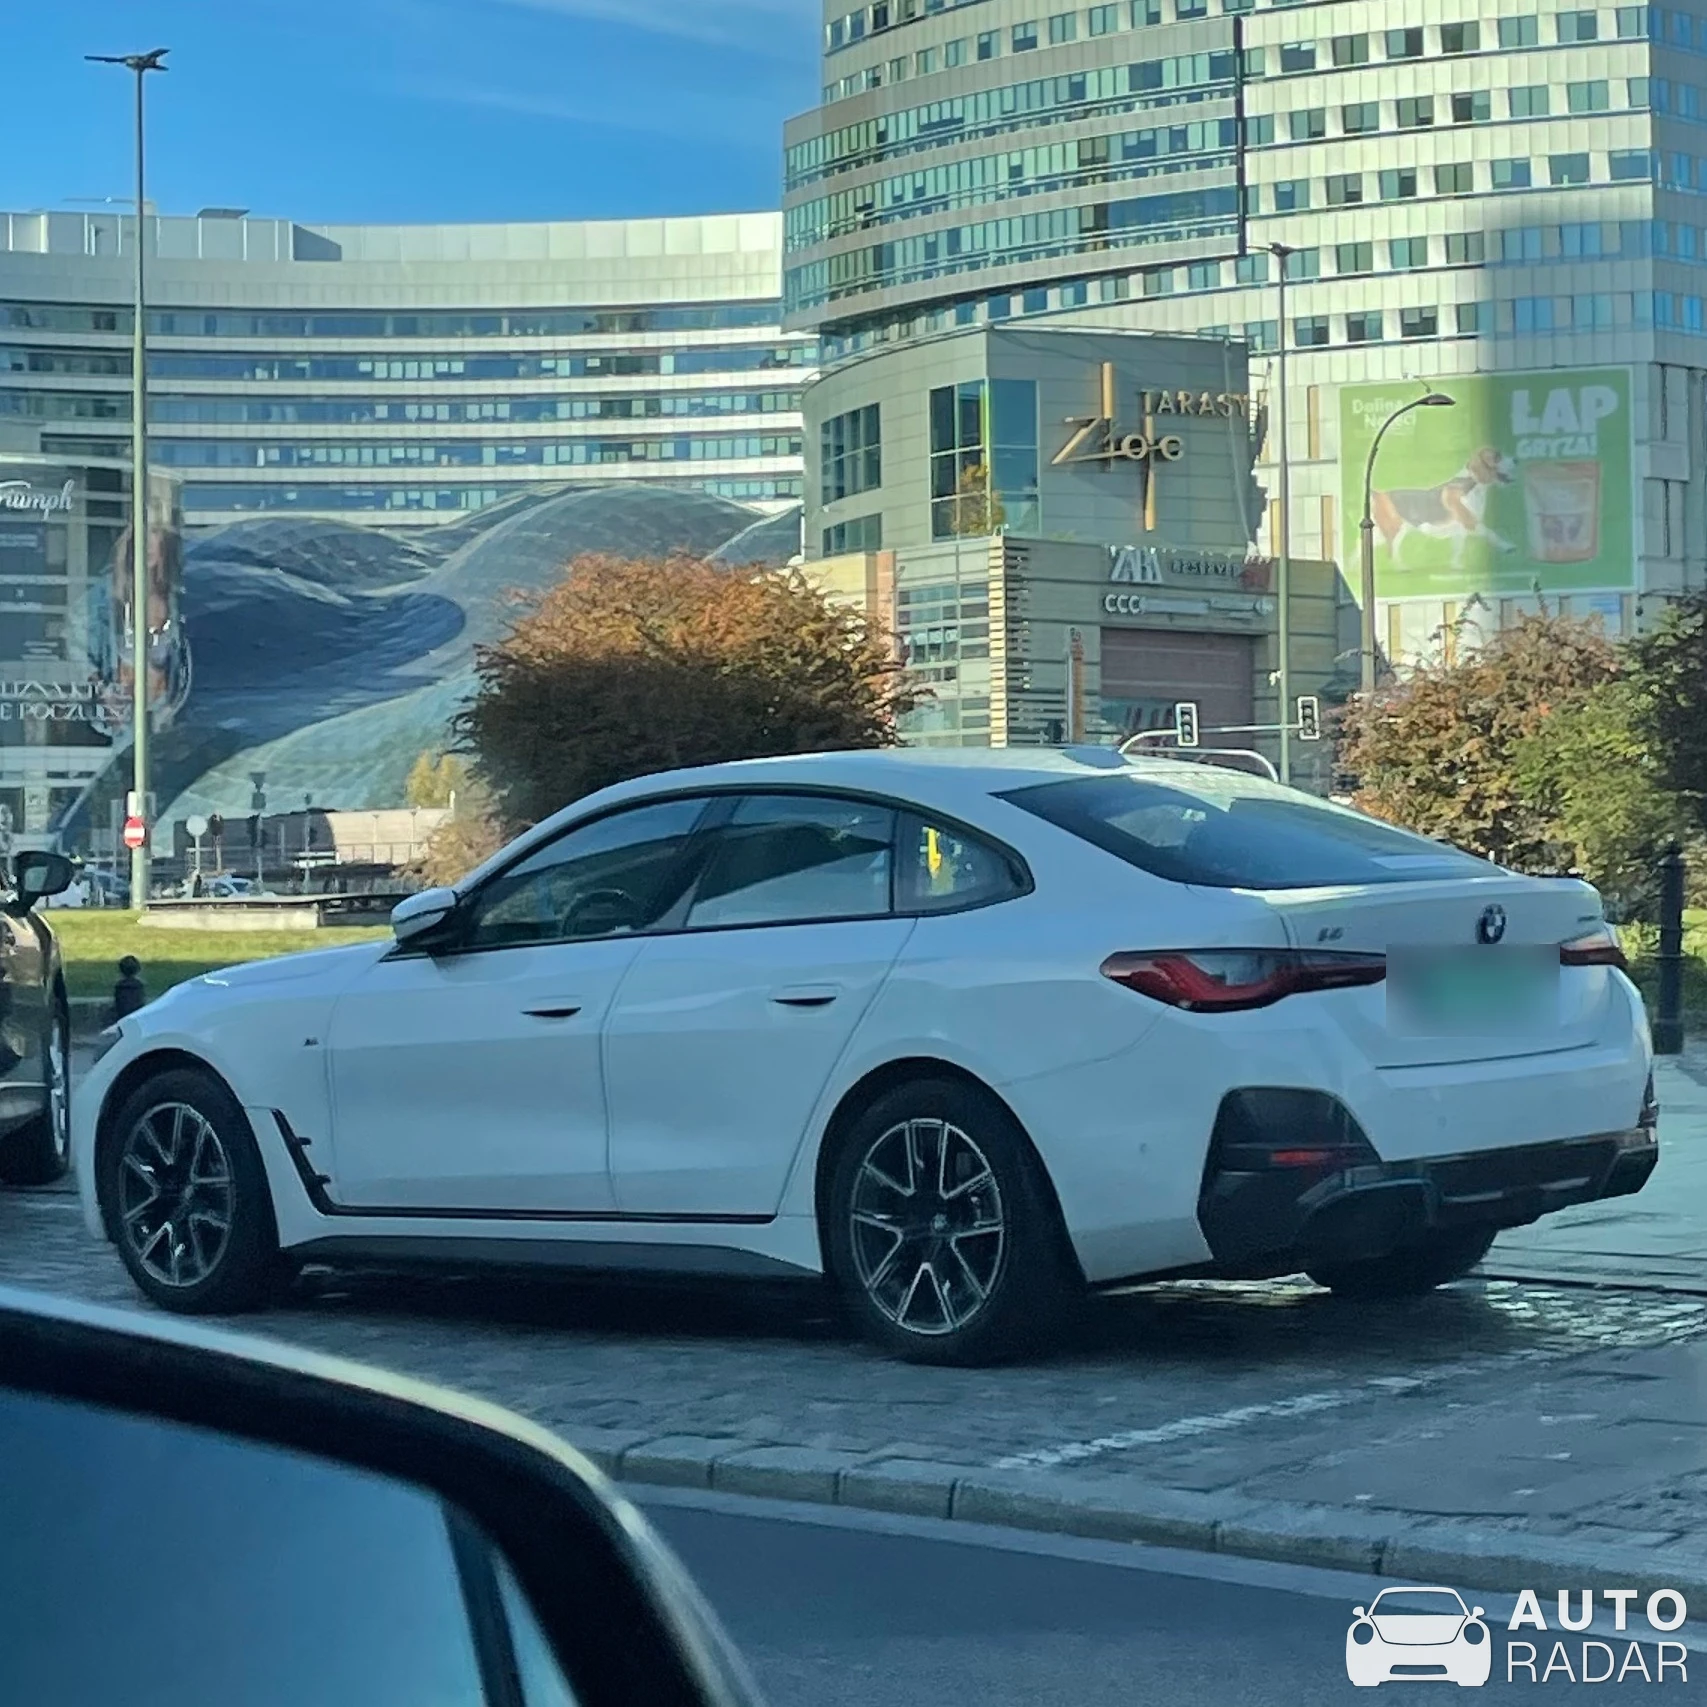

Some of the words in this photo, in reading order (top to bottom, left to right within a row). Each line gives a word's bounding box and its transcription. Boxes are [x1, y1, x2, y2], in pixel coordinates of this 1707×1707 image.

[1140, 388, 1249, 417] TARASY
[0, 479, 75, 521] iumph
[1104, 593, 1141, 614] CCC
